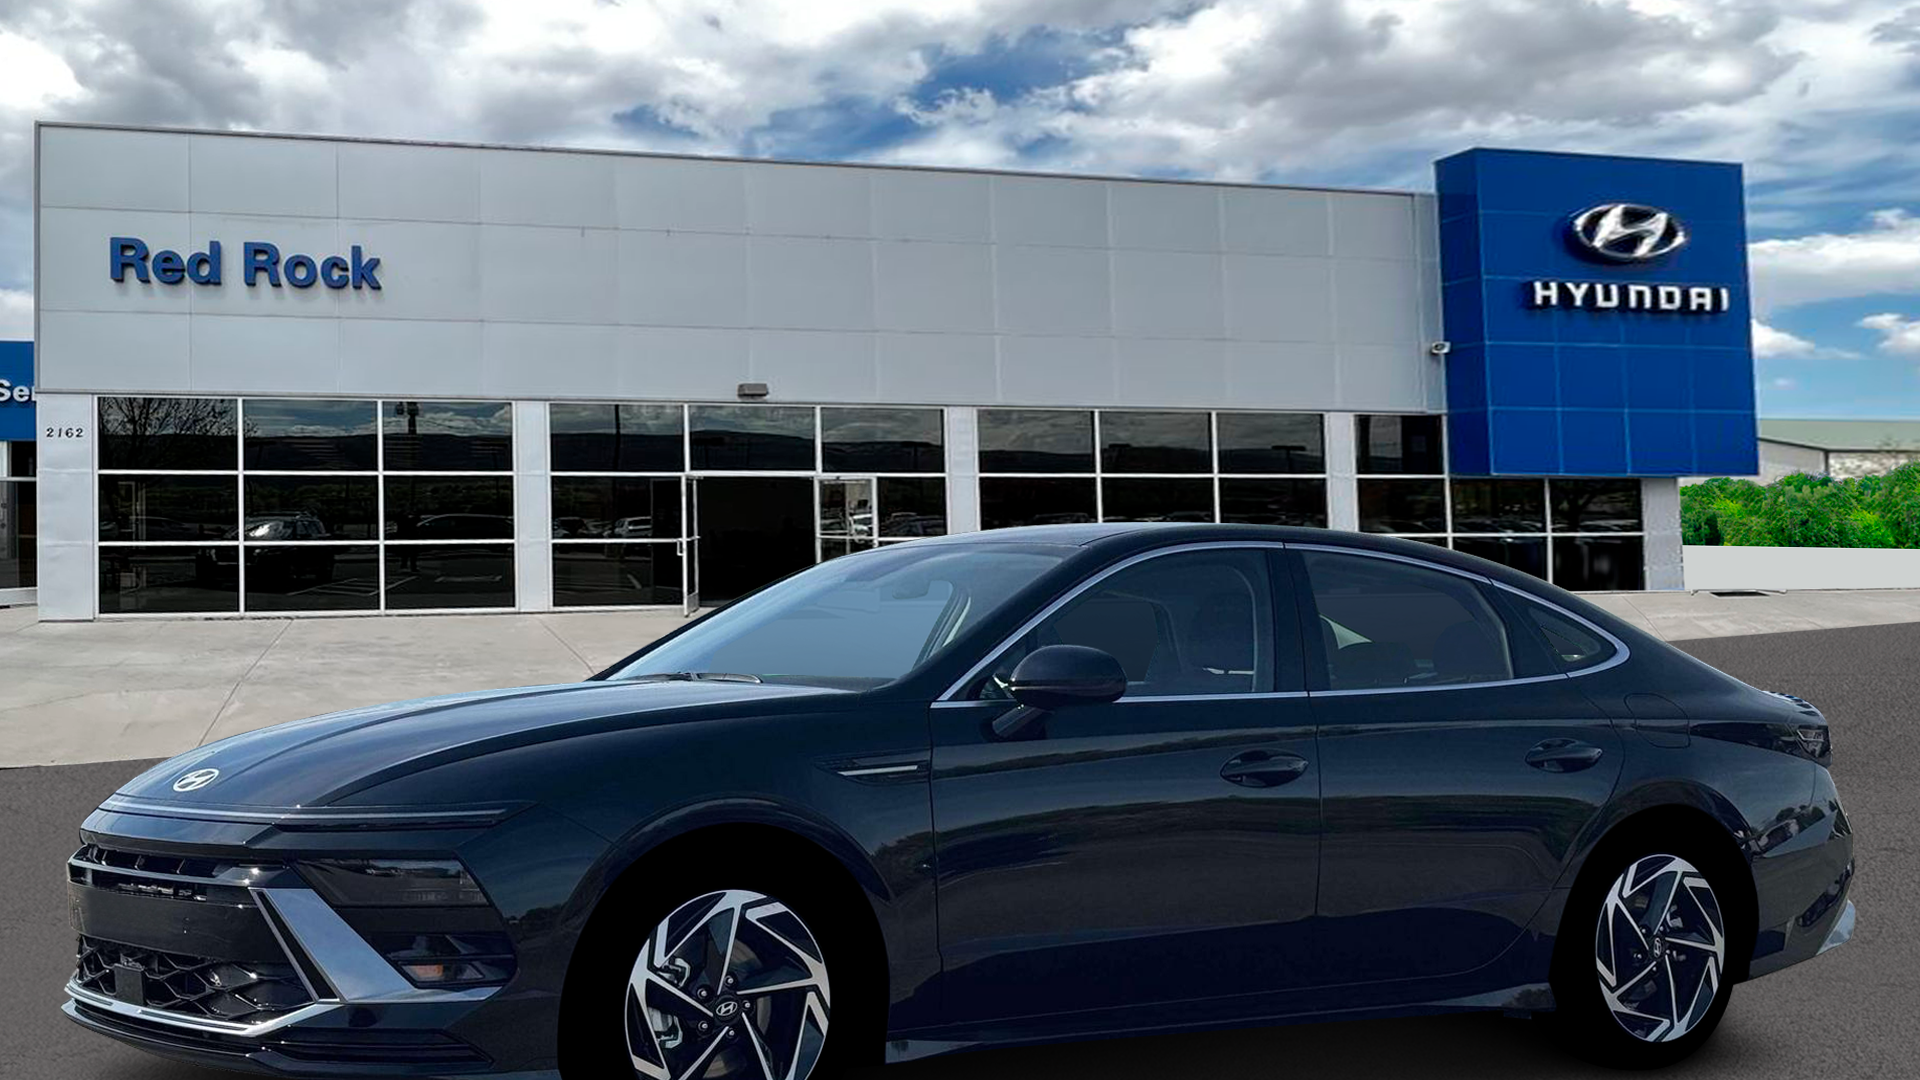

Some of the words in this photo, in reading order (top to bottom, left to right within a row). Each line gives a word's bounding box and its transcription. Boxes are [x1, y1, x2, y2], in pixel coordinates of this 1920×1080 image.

[109, 236, 222, 285] Red
[243, 241, 382, 291] Rock
[1533, 280, 1730, 312] HYUNDAI
[45, 427, 84, 438] 2162
